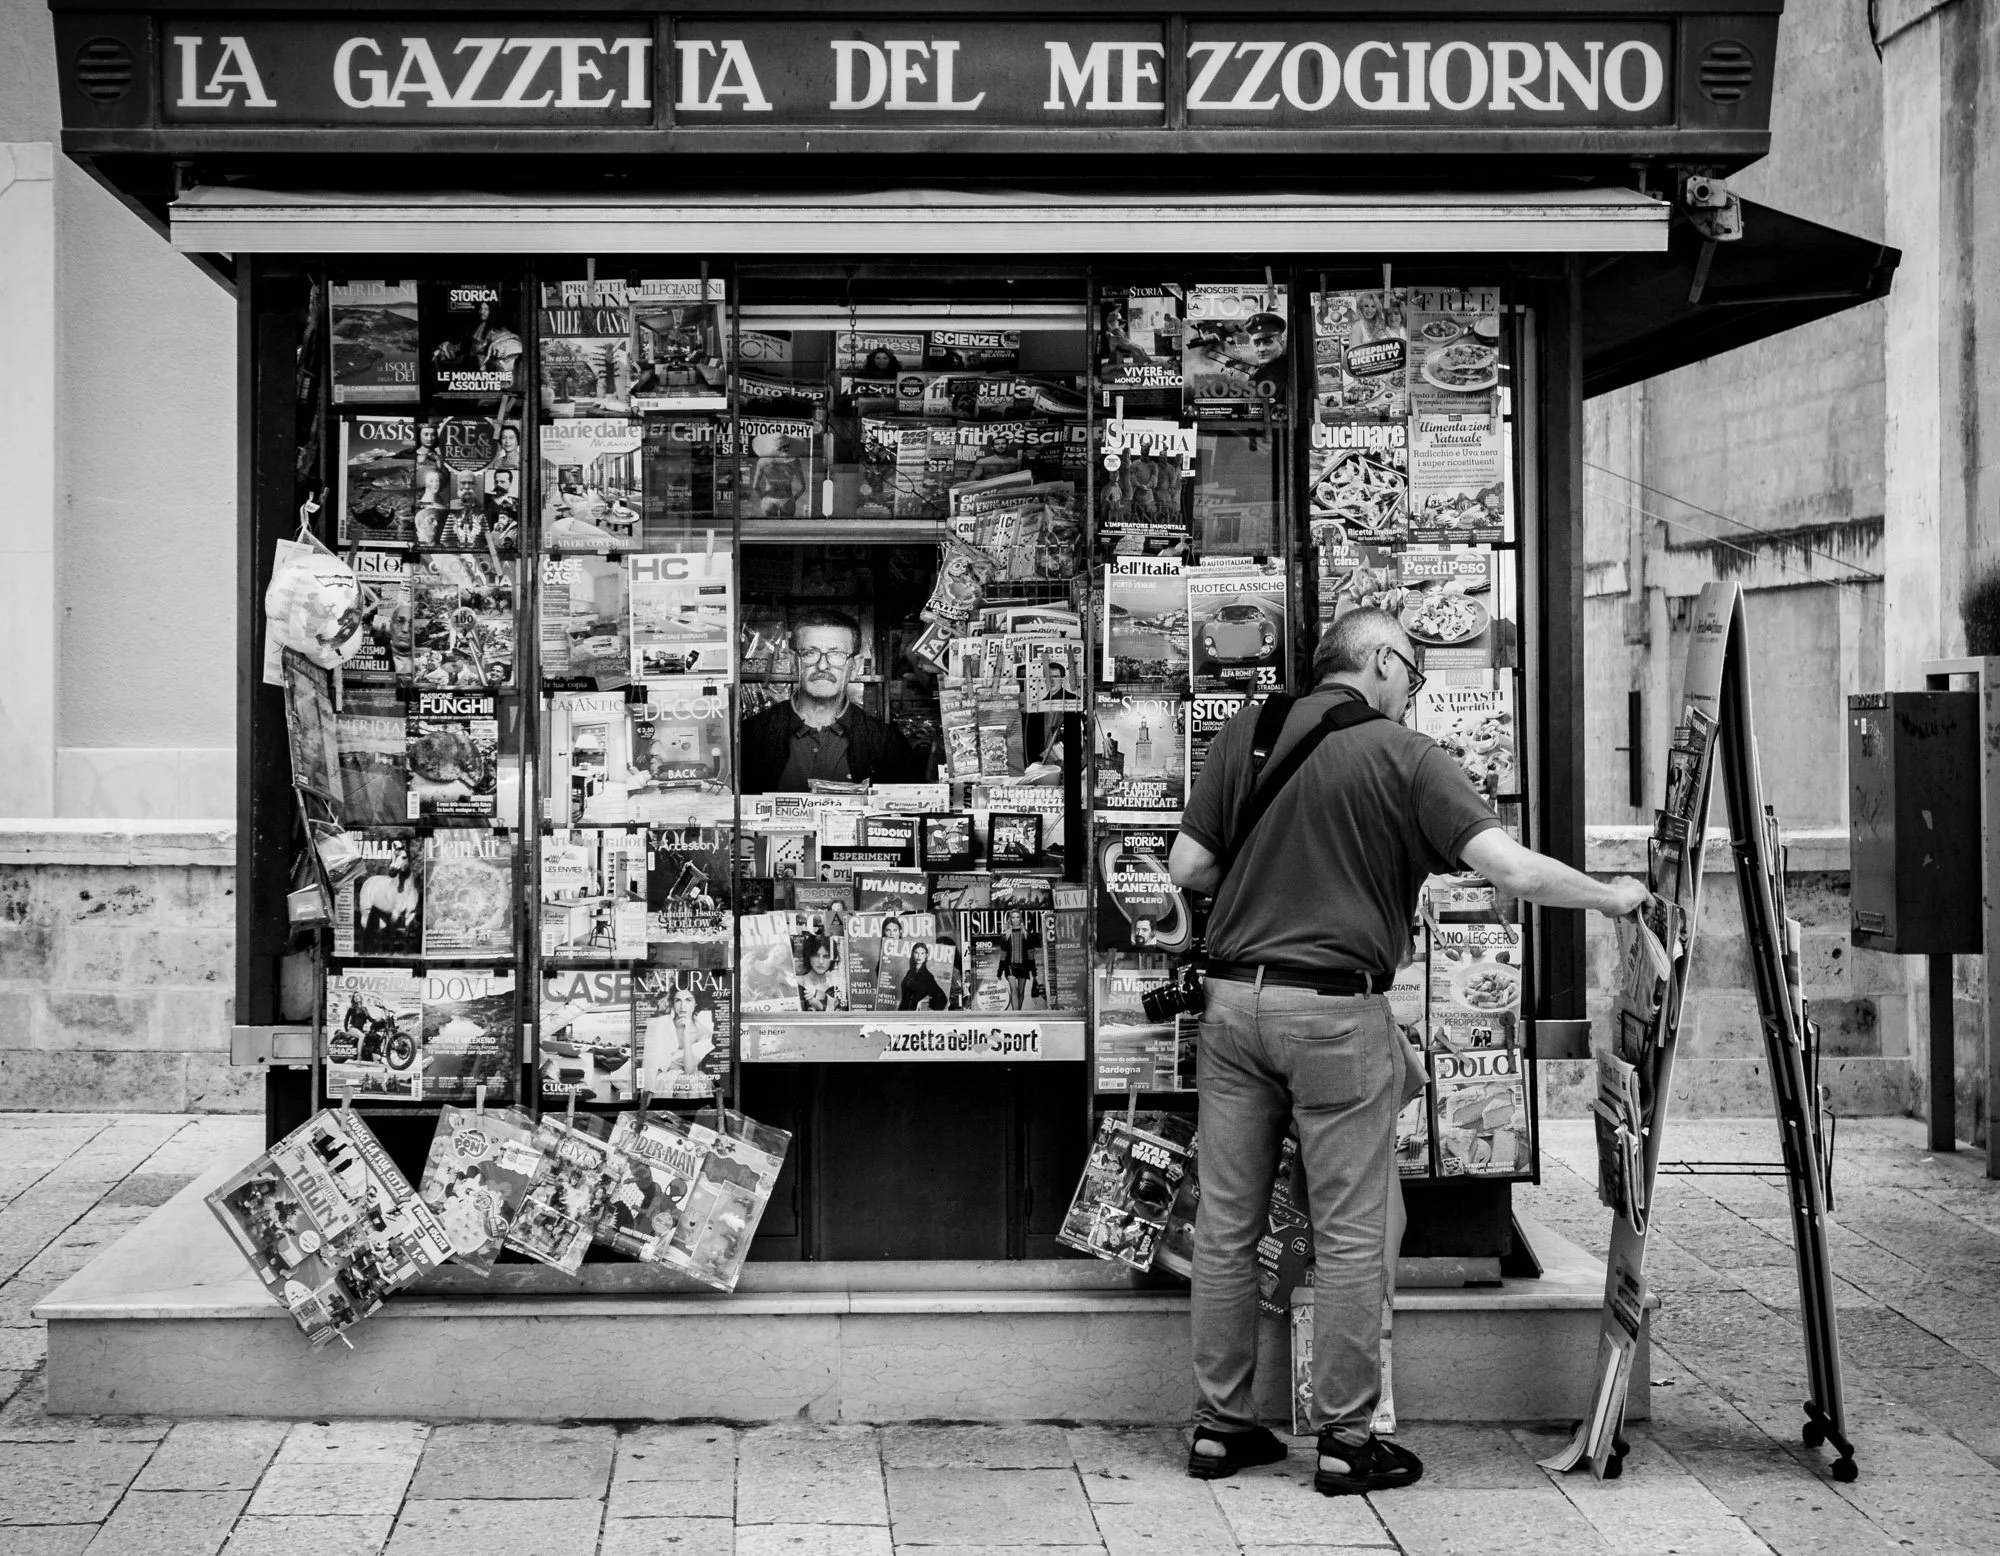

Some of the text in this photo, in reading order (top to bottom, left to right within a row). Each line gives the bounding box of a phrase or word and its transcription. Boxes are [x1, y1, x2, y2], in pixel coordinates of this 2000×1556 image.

[173, 35, 1664, 112] LA GAZZETTA DEL MEZZOGIORNO
[334, 283, 416, 296] MERIDIANI
[565, 283, 626, 293] PROETTO
[1130, 286, 1163, 297] STORIA
[450, 290, 498, 301] STORICA
[934, 332, 999, 346] SCIENZE
[1348, 342, 1400, 359] ANTEPRIMA
[1352, 350, 1399, 366] RICETTE TV
[385, 362, 415, 371] ISOLE
[1124, 367, 1163, 376] VIVERE
[395, 372, 415, 381] DEI
[437, 372, 512, 381] LE MONARCHIE
[1142, 376, 1183, 386] ANTICO
[449, 381, 501, 390] ASSOLUTE
[1194, 380, 1276, 398] ROSSO
[359, 423, 415, 441] OASIS
[543, 420, 639, 439] marie claire
[739, 422, 811, 437] HOTOGRAPHY
[982, 422, 1022, 432] uomo
[446, 425, 490, 446] RE &
[1107, 421, 1190, 452] STORIA
[1312, 422, 1405, 448] Cucinare
[1430, 432, 1481, 443] Naturale
[445, 446, 493, 459] REGINE
[1414, 450, 1453, 458] Radicchio
[1422, 460, 1445, 468] super
[1447, 458, 1495, 466] ricostituenti
[1319, 545, 1349, 556] VRO
[1319, 557, 1359, 566] ccina
[632, 558, 689, 581] HC
[1110, 561, 1180, 576] Bell'Italia
[1403, 561, 1486, 575] PerdiPeso
[543, 572, 581, 584] CASA
[453, 614, 474, 623] 100
[1256, 667, 1276, 684] 33
[568, 681, 588, 689] copia
[1426, 691, 1503, 703] ANTIPASTI
[420, 699, 487, 713] FUNGHI
[547, 698, 624, 712] CASANTIC
[644, 698, 723, 721] DECOR
[1434, 703, 1495, 713] & Aperitivi
[338, 720, 405, 734] MERIDIA
[668, 769, 697, 779] BACK
[1119, 782, 1167, 790] LE ANTICHE
[1124, 790, 1162, 798] CAPITALI
[1107, 798, 1178, 808] DIMENTICATE
[867, 827, 912, 838] SUDOKU
[659, 842, 716, 854] Accessory
[1124, 837, 1165, 847] STORICA
[832, 853, 901, 861] ESPERIMENTI
[1126, 864, 1135, 872] IL
[1107, 873, 1172, 882] MOVIMENT
[862, 879, 900, 893] DYLAN
[900, 881, 925, 895] DOG
[668, 919, 710, 928] FOLLOW
[849, 916, 934, 938] GLAOUR
[428, 977, 495, 1000] DOVE
[542, 972, 631, 1004] CASE
[633, 971, 725, 994] NATURAL
[712, 988, 730, 999] style
[990, 1028, 1038, 1055] Sport
[1099, 1066, 1140, 1074] Sardegna
[1438, 1054, 1518, 1079] DOLCI
[454, 1137, 488, 1154] PONY
[1138, 1141, 1170, 1158] STAR
[366, 1142, 380, 1156] LA
[375, 1150, 389, 1171] TUA
[1131, 1147, 1171, 1169] WARS
[413, 1206, 448, 1250] PRIMA USCITA
